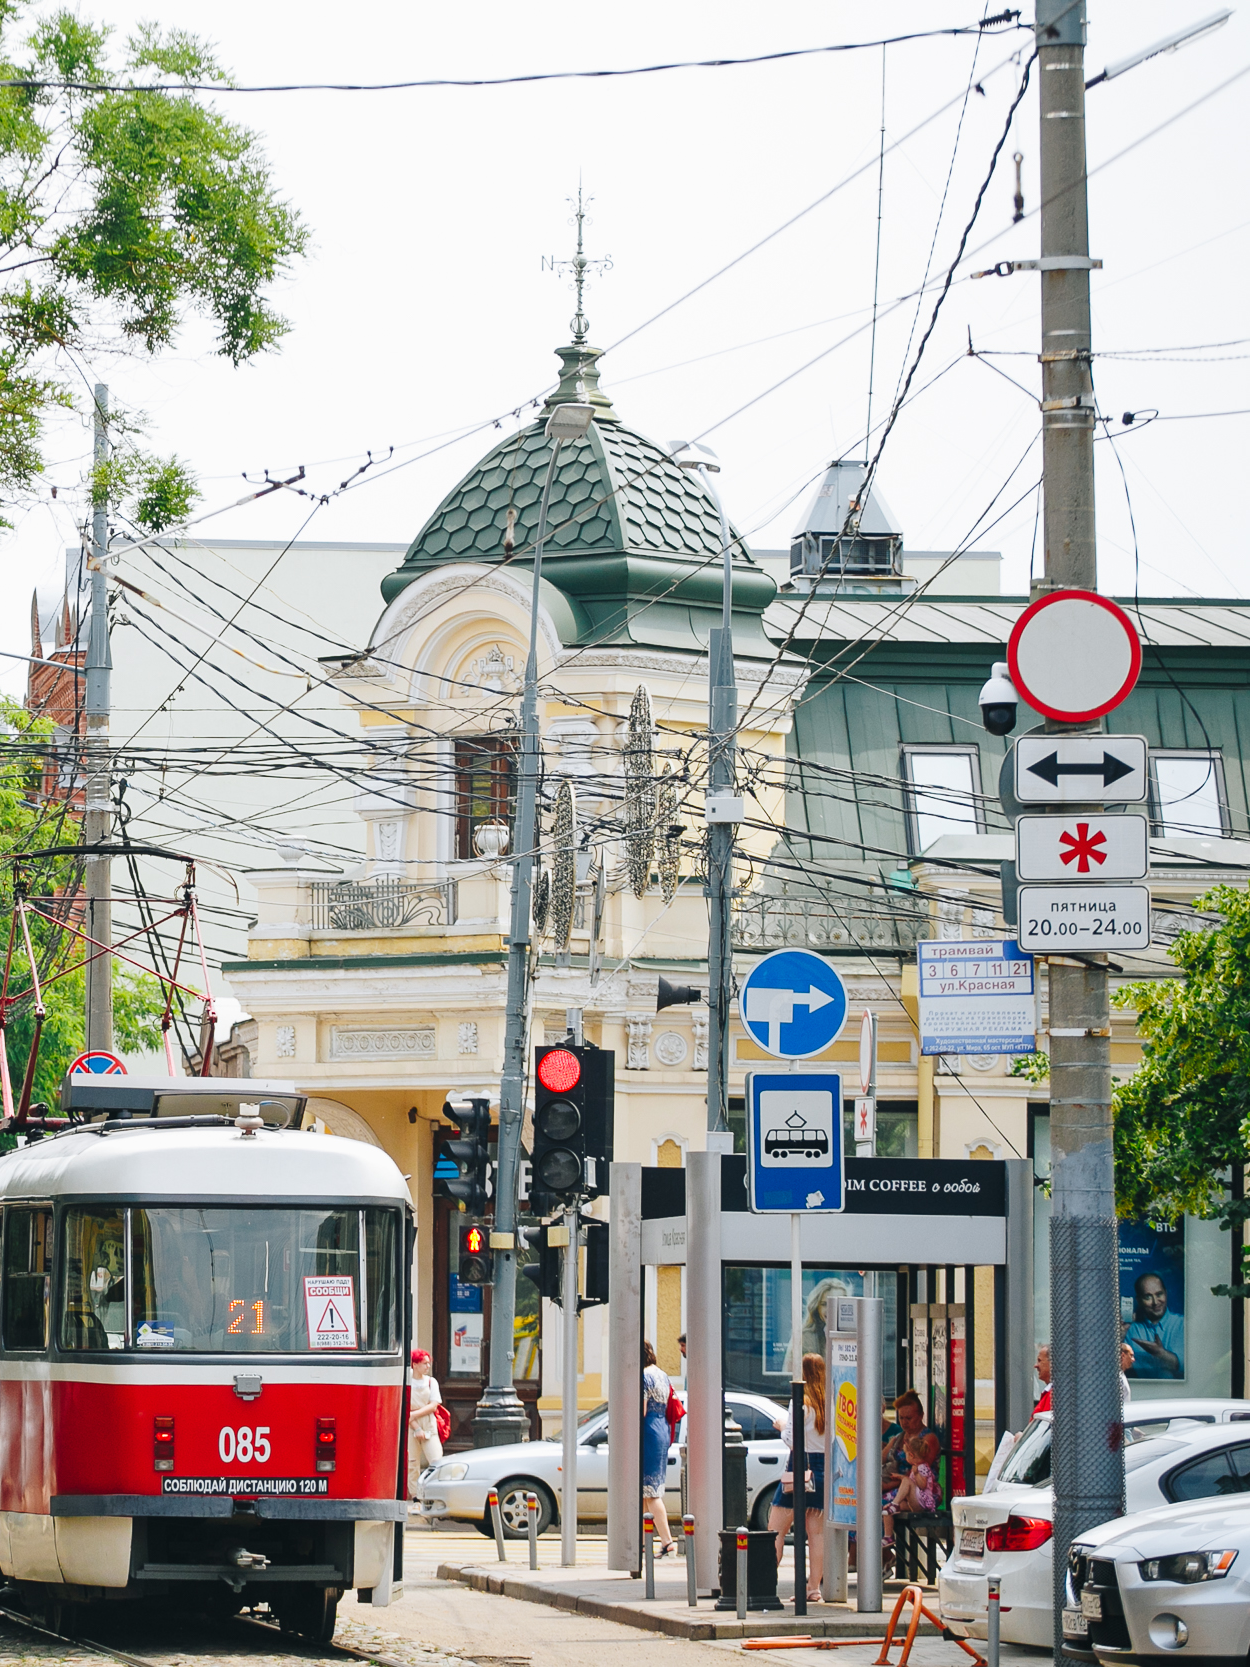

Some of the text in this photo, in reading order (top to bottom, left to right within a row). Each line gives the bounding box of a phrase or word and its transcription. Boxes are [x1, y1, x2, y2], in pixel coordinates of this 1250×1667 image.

[1051, 902, 1117, 913] пятница
[931, 945, 993, 958] трамвай
[929, 962, 1028, 977] 3 6 7 11 21
[940, 980, 1015, 993] ул.Красная
[869, 1179, 927, 1192] COFFEE
[943, 1178, 980, 1193] собой
[310, 1287, 349, 1296] СООБЩИ
[227, 1299, 265, 1334] 21
[317, 1333, 350, 1341] 222-20-16
[218, 1426, 271, 1463] 085
[164, 1477, 327, 1494] СОБЛЮДАЙ ДИСТАНЦИЮ 120 М
